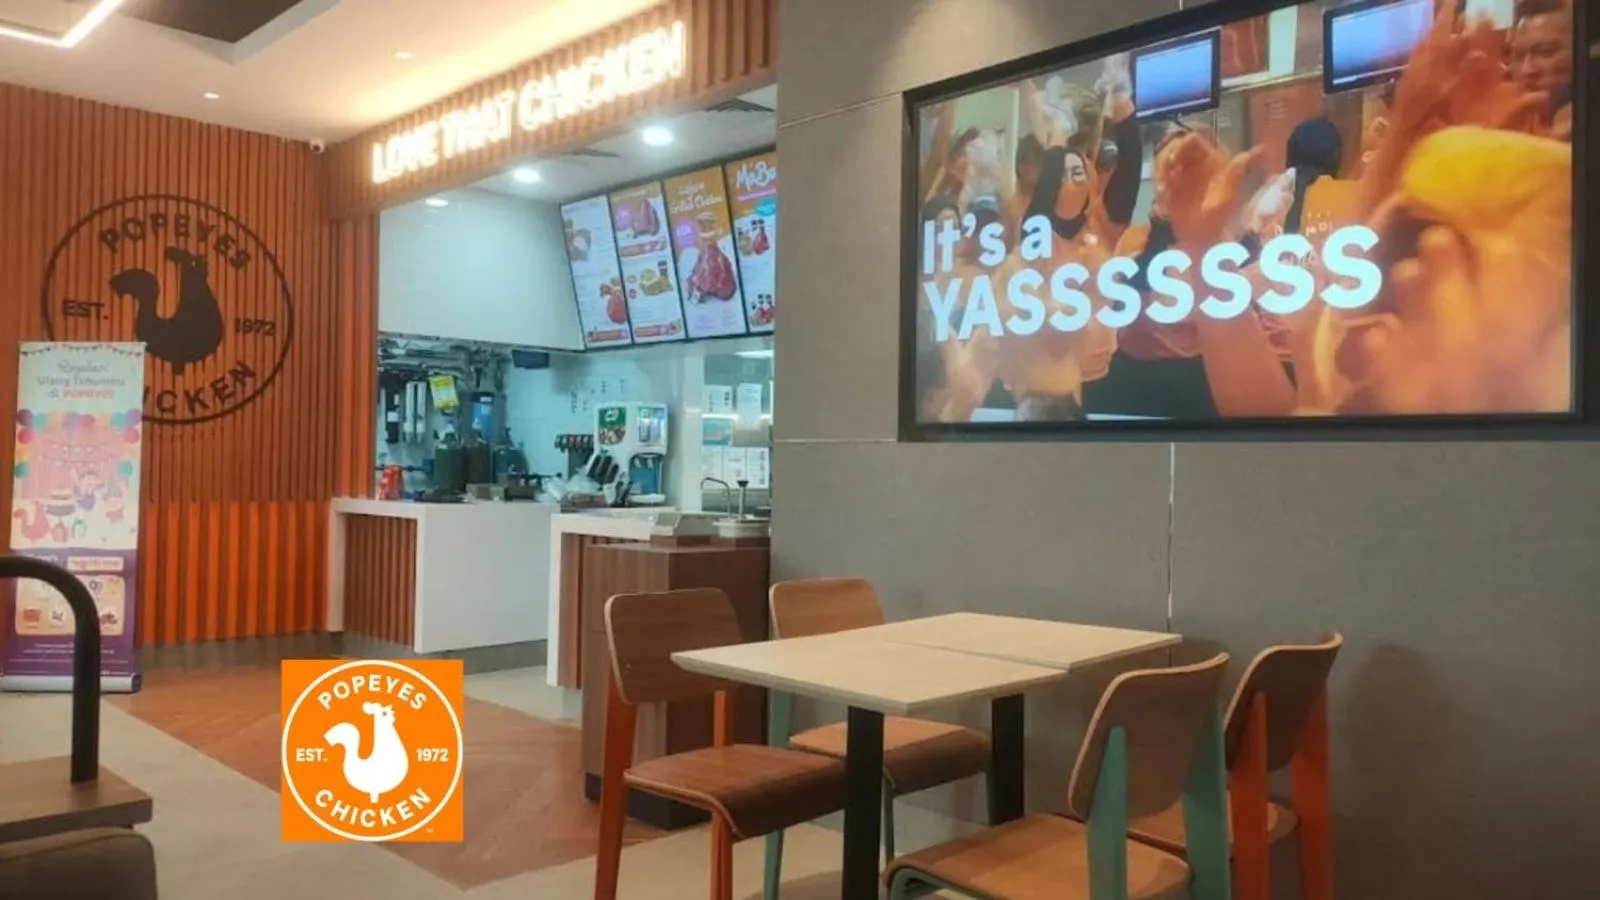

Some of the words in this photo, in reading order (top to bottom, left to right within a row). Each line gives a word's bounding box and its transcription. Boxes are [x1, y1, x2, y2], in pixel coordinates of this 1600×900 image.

[372, 119, 440, 184] LOVE
[439, 90, 515, 158] THAT
[518, 20, 686, 131] CHICKEN
[100, 213, 251, 269] POPEYES
[923, 212, 1006, 275] It’s
[1020, 214, 1052, 261] a
[61, 298, 109, 320] EST.
[922, 224, 1383, 343] YASSSSSSS
[235, 317, 276, 337] 1972
[142, 360, 257, 415] ICKEN
